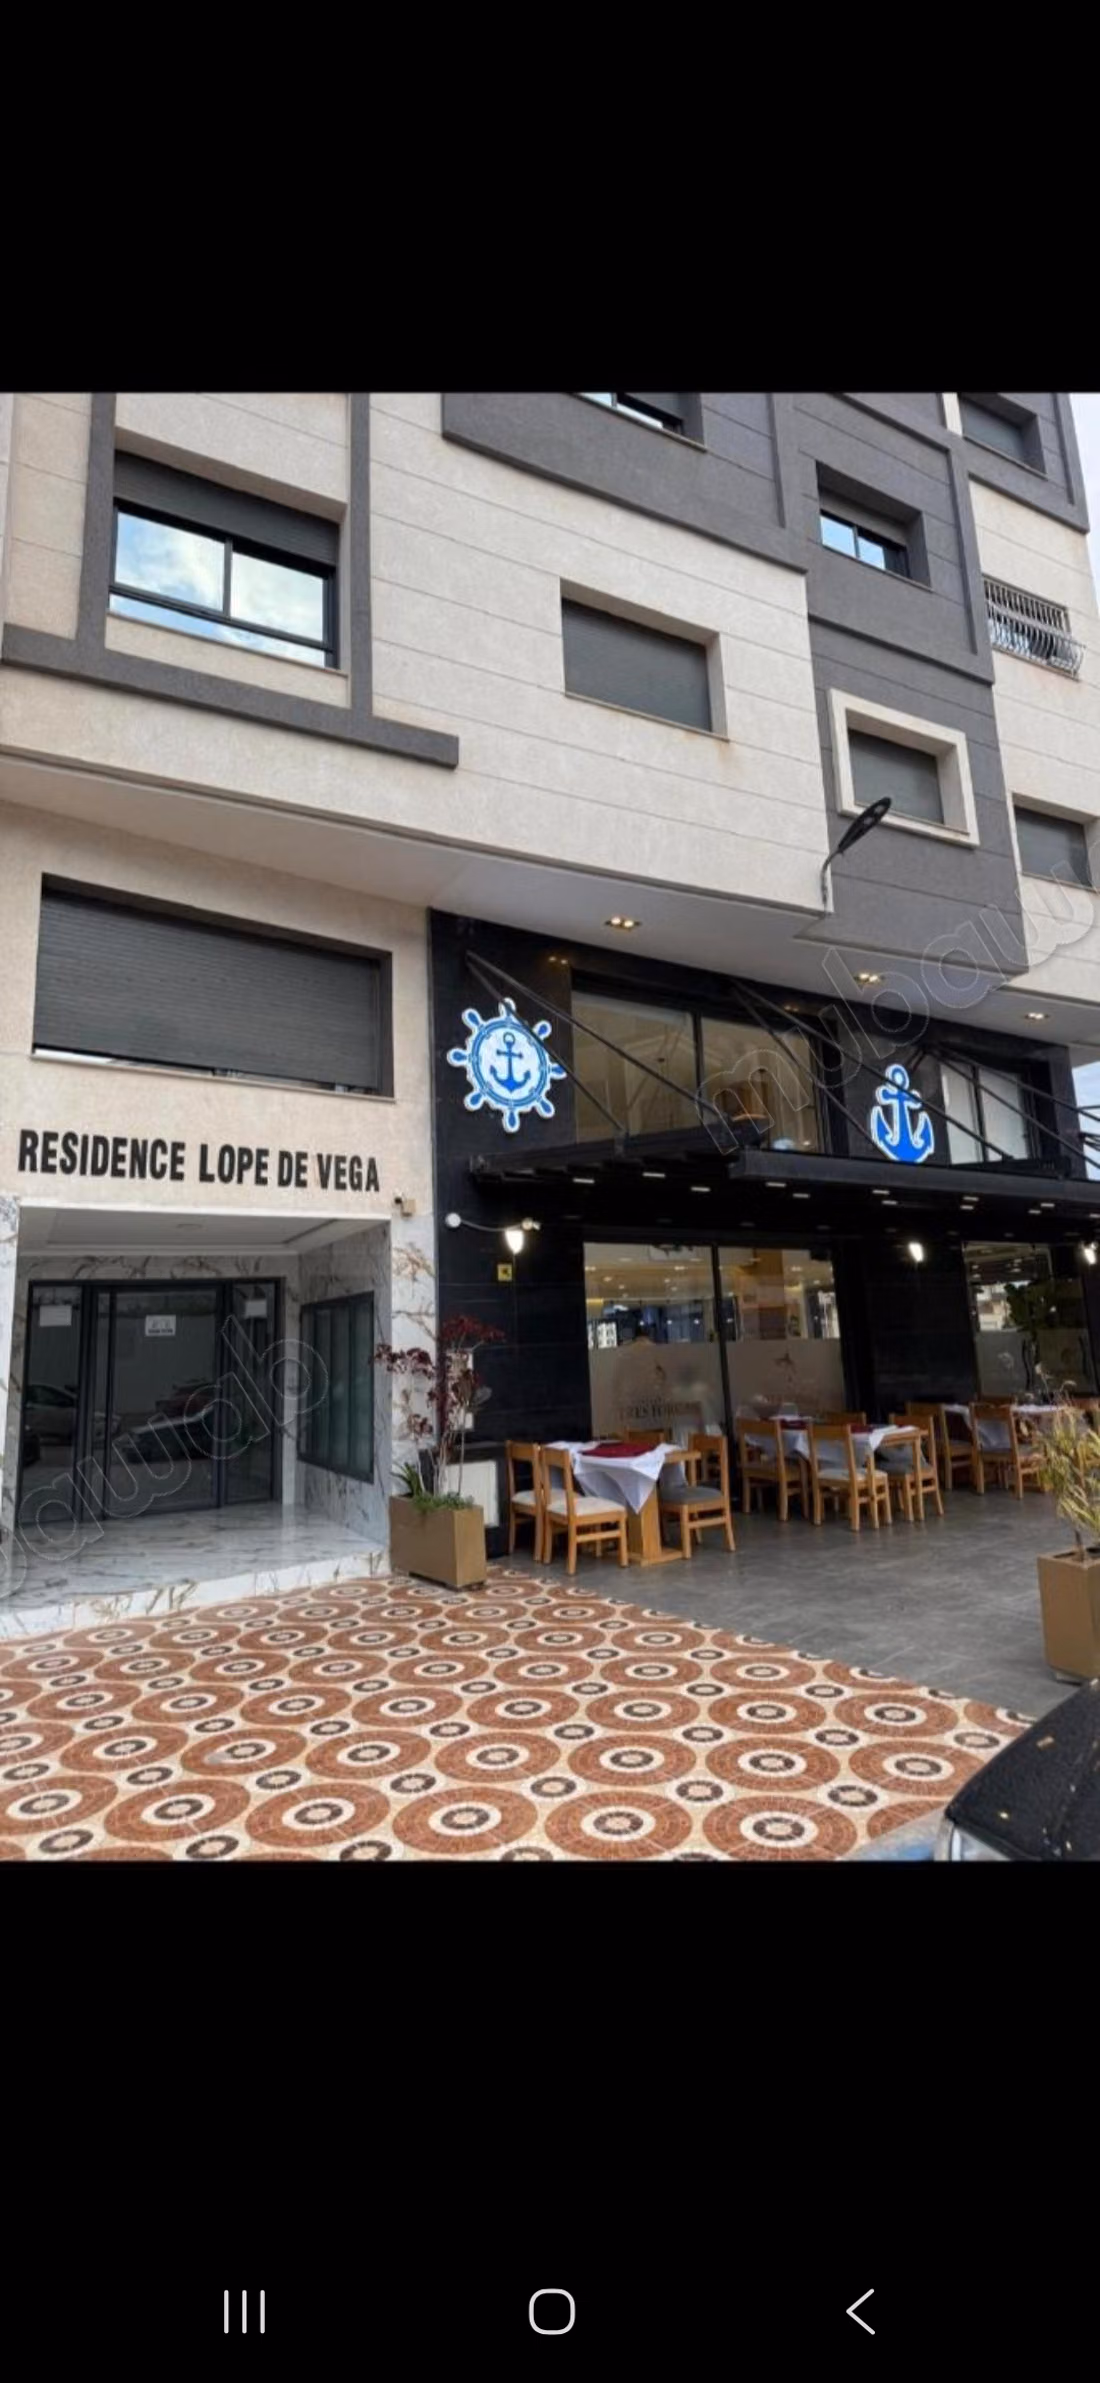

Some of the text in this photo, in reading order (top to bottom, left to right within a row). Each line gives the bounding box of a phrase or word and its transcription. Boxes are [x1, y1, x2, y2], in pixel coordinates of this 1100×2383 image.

[18, 1129, 380, 1192] RESIDENCE LOPE DE VEGA
